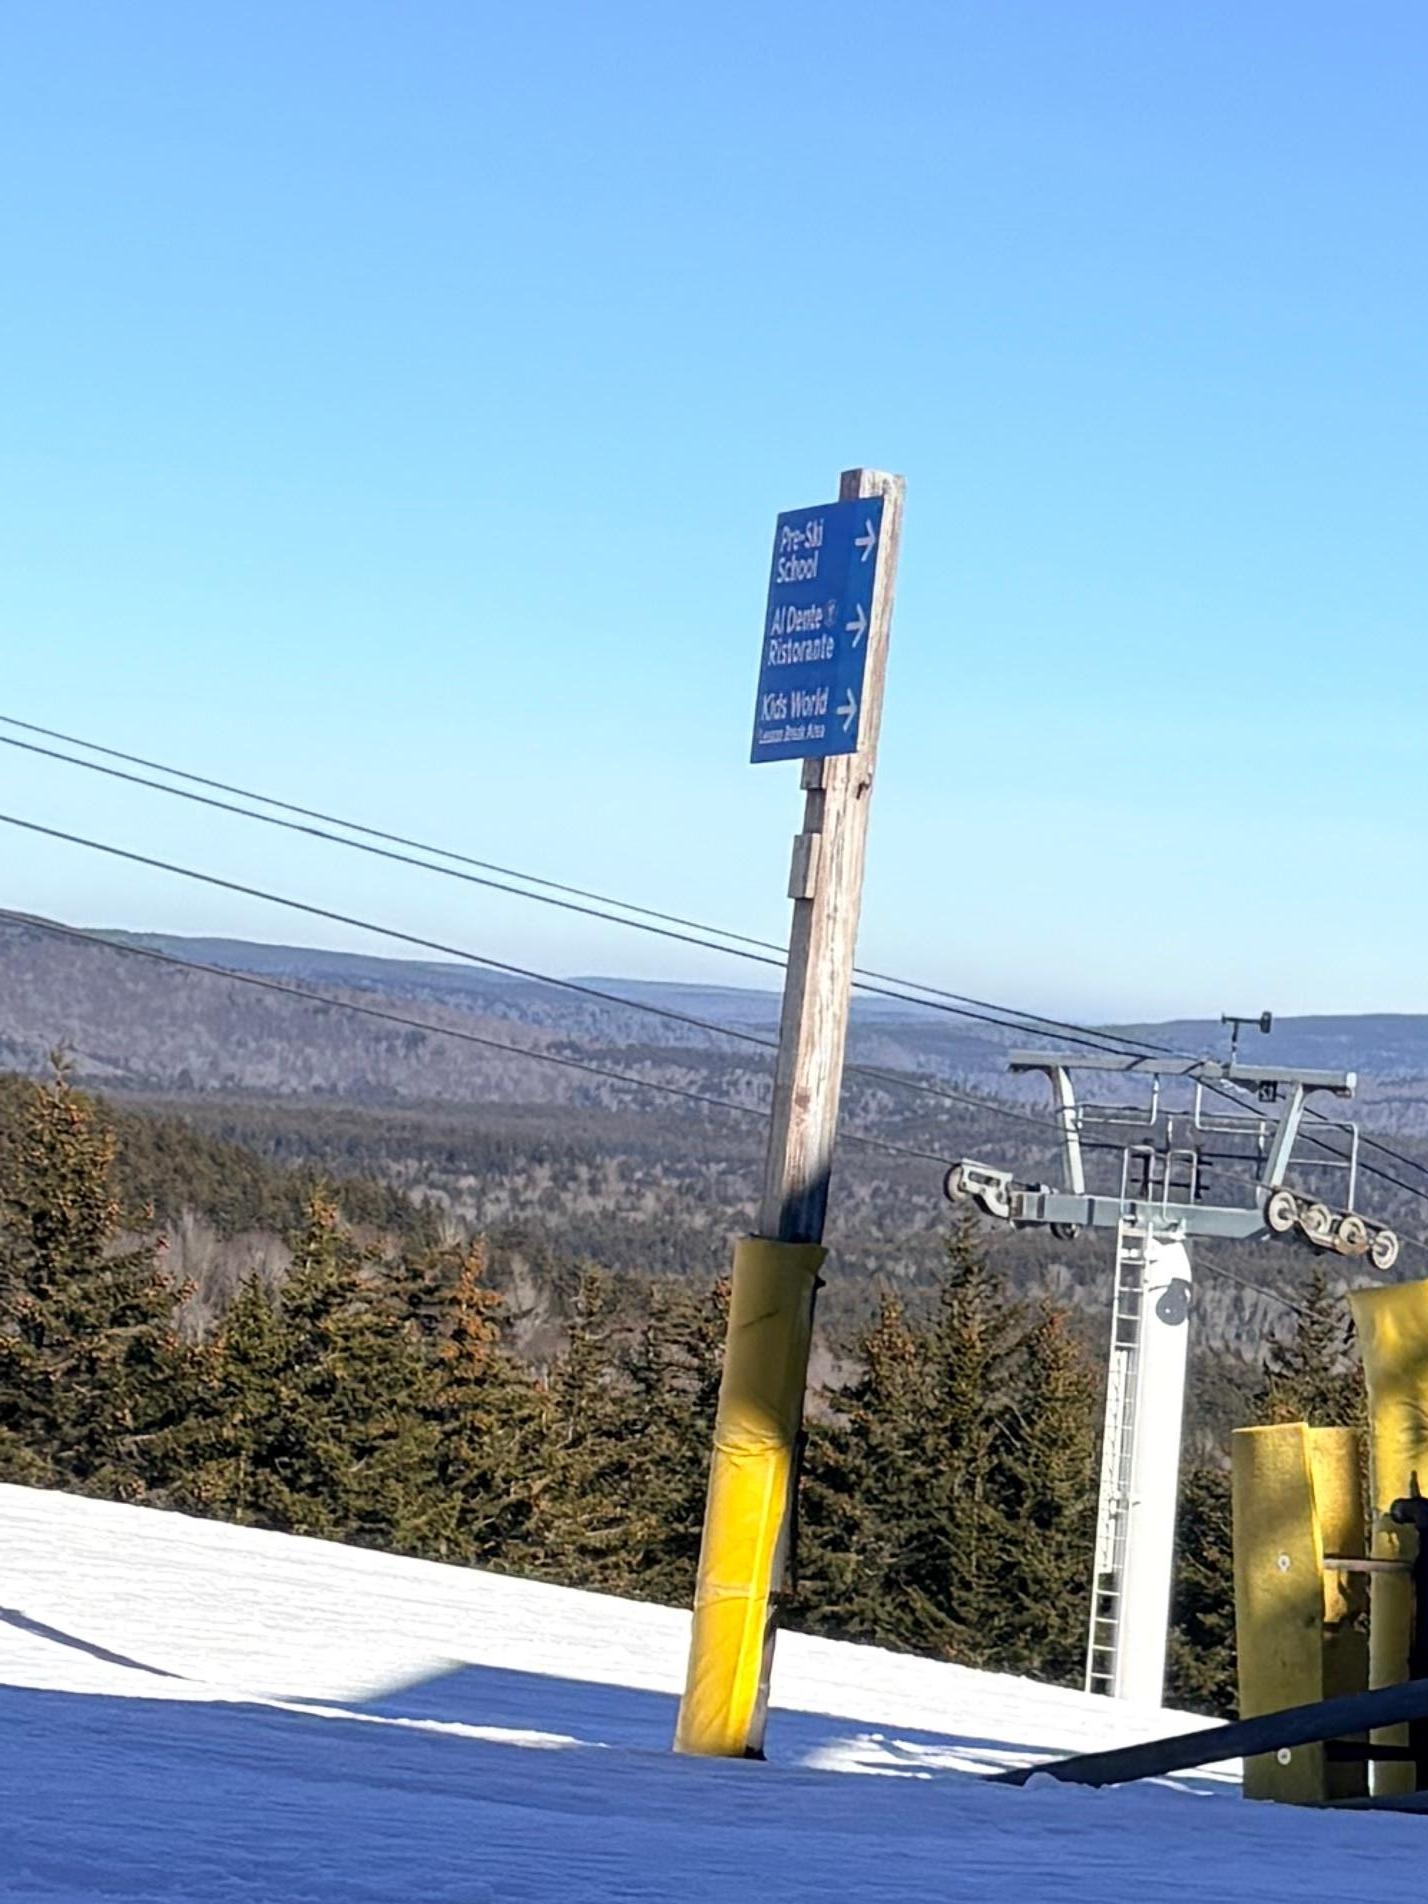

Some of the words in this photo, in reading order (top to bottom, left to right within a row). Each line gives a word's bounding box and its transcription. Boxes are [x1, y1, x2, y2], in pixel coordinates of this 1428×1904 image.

[780, 518, 824, 552] Pre-Ski
[777, 550, 819, 583] School
[770, 606, 786, 635] Al
[786, 604, 823, 634] Dente
[768, 634, 834, 666] Ristorante
[761, 692, 787, 720] Kids
[791, 686, 829, 718] World
